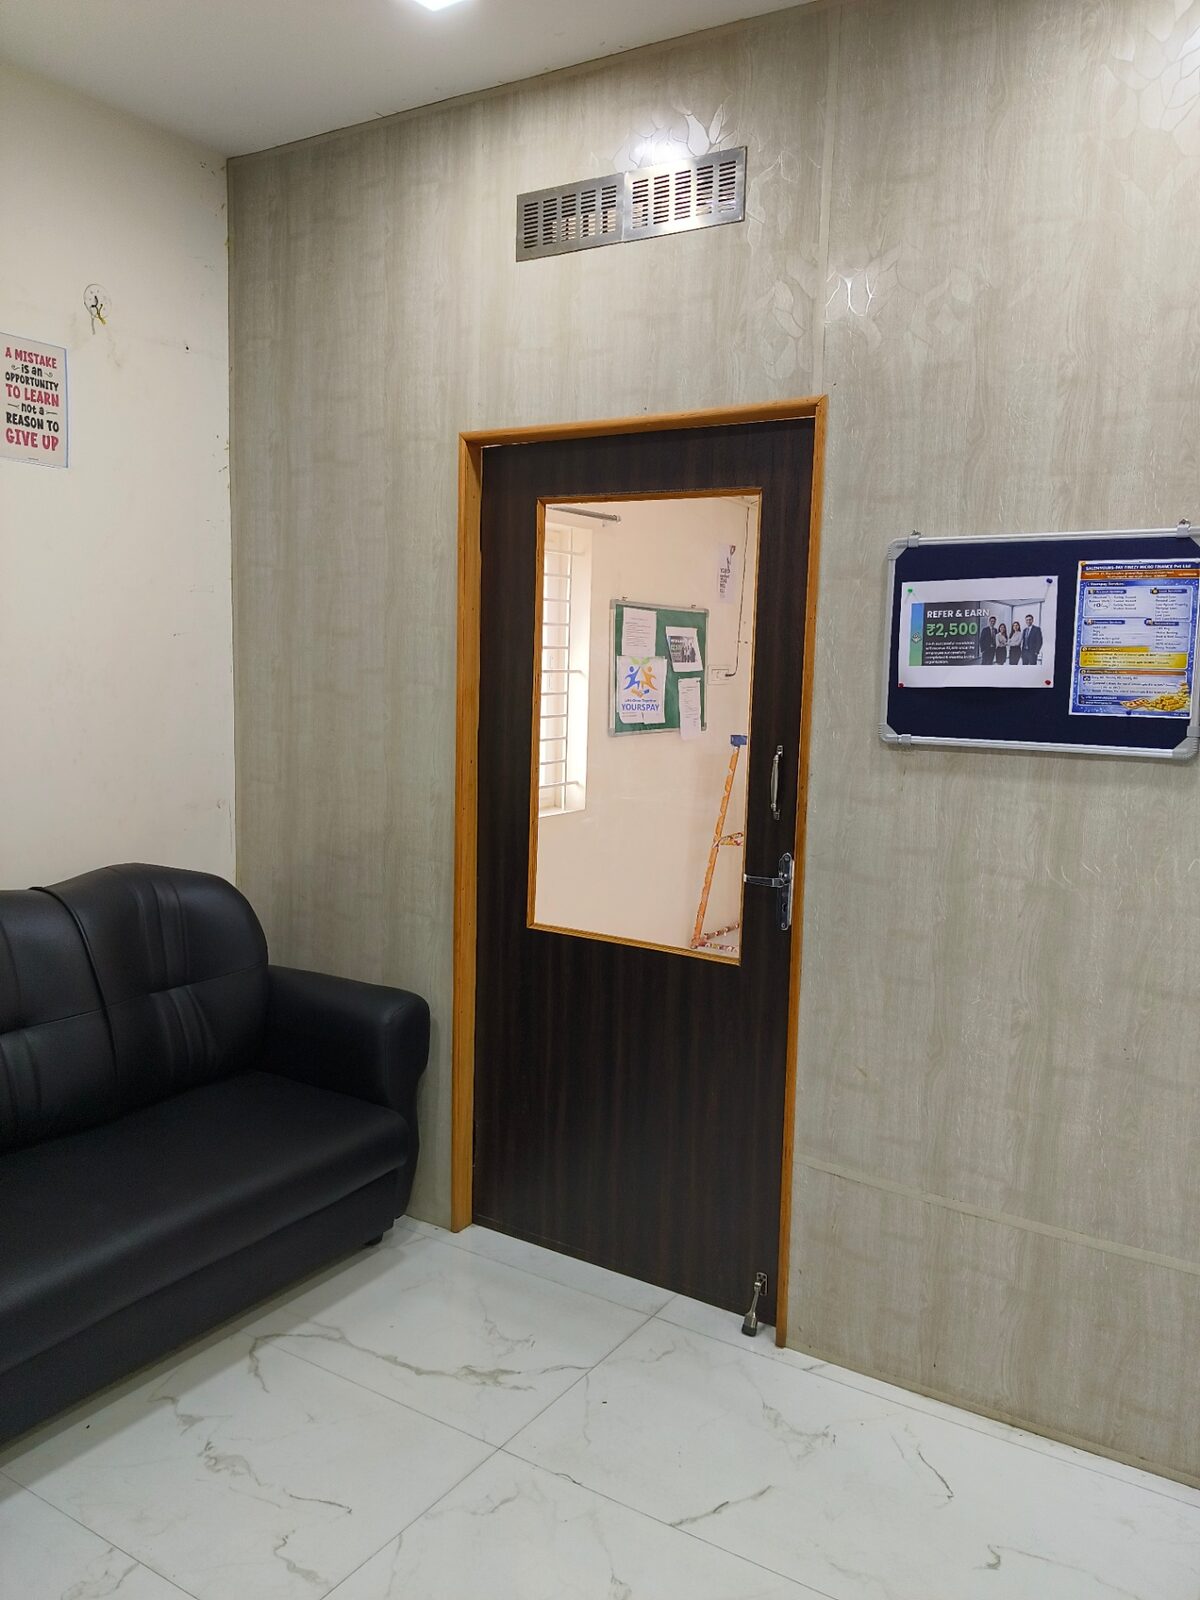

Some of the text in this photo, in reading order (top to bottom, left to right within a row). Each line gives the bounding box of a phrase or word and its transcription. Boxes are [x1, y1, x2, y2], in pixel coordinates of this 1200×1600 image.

[5, 347, 57, 369] A MISTAKE
[21, 363, 43, 378] is an
[5, 371, 59, 391] OPPORTUNITY
[5, 383, 60, 407] TO LEARN
[21, 402, 45, 416] not a
[6, 411, 60, 433] REASON TO
[6, 427, 60, 451] GIVE UP
[926, 609, 989, 618] REFER & EARN
[926, 622, 978, 638] ₹2,500
[621, 703, 659, 711] YOURSPAY
